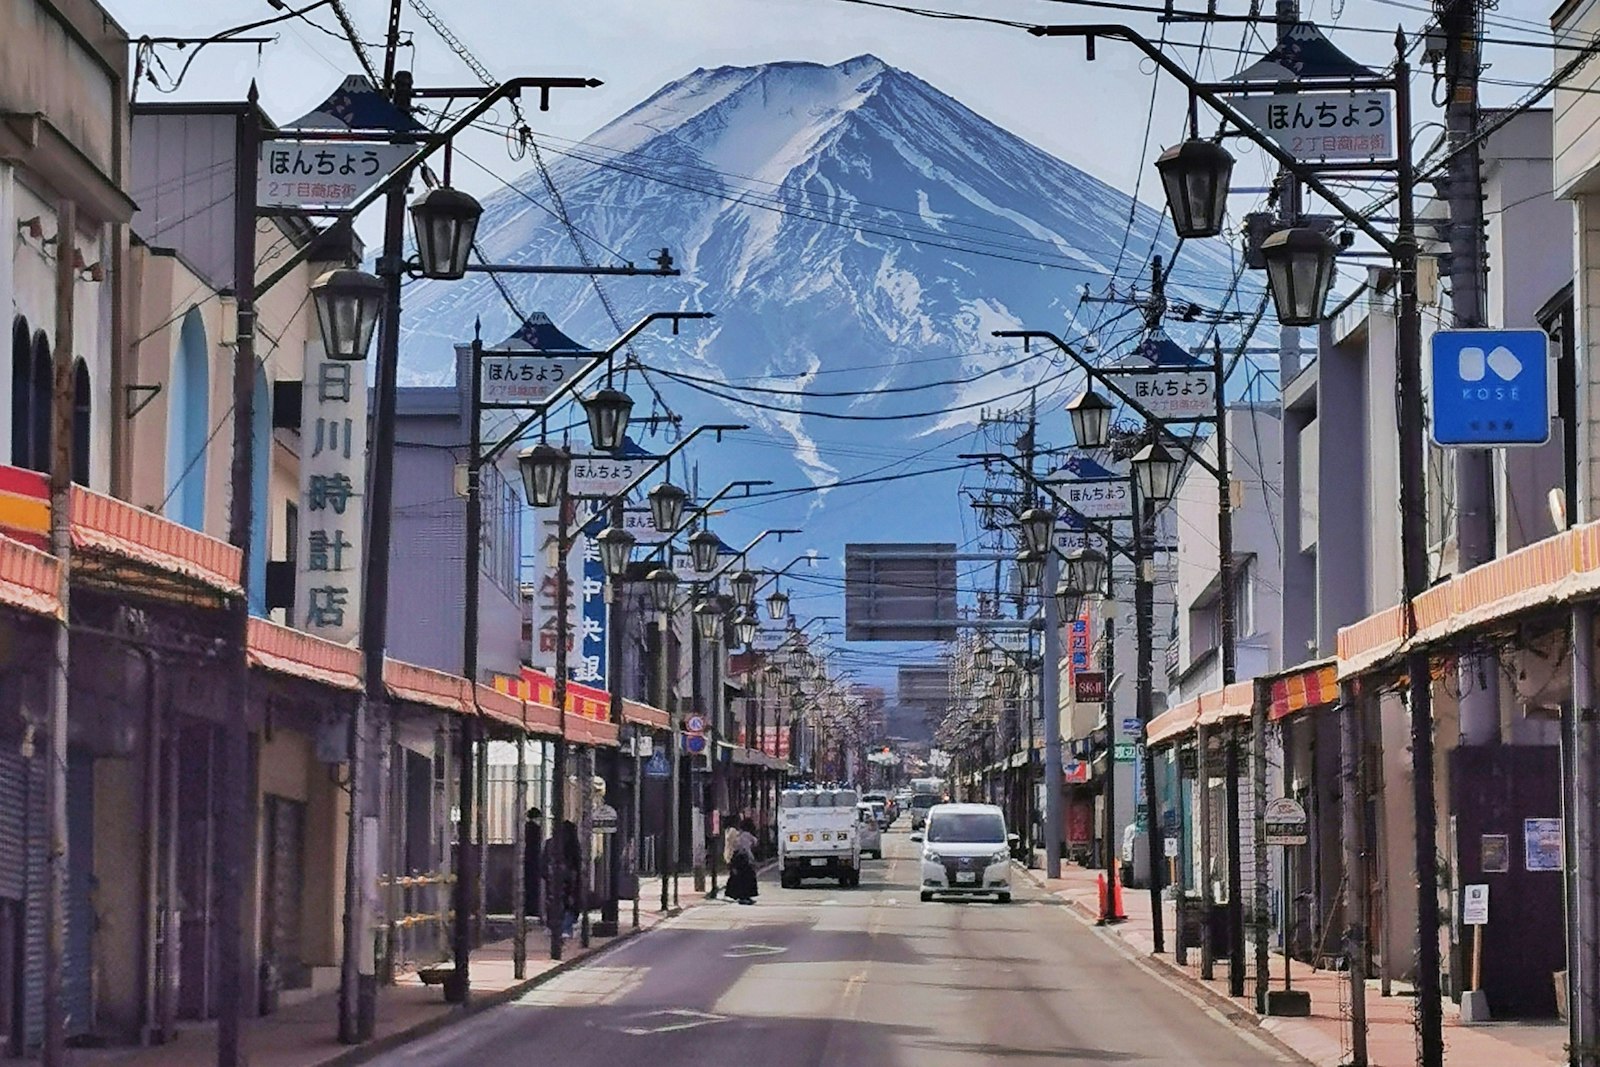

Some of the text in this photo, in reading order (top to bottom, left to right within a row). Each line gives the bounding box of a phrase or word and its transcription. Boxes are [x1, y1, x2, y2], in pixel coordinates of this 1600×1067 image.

[1268, 99, 1385, 130] ほんちょう
[1292, 134, 1385, 153] 2丁目商店街
[269, 149, 380, 177] ほんちょう
[268, 181, 357, 200] 2丁目商店街
[489, 364, 564, 382] ほんちょう
[1135, 378, 1208, 397] ほんちょう
[574, 465, 633, 479] ほんちょう
[1070, 486, 1126, 501] ほんちょう
